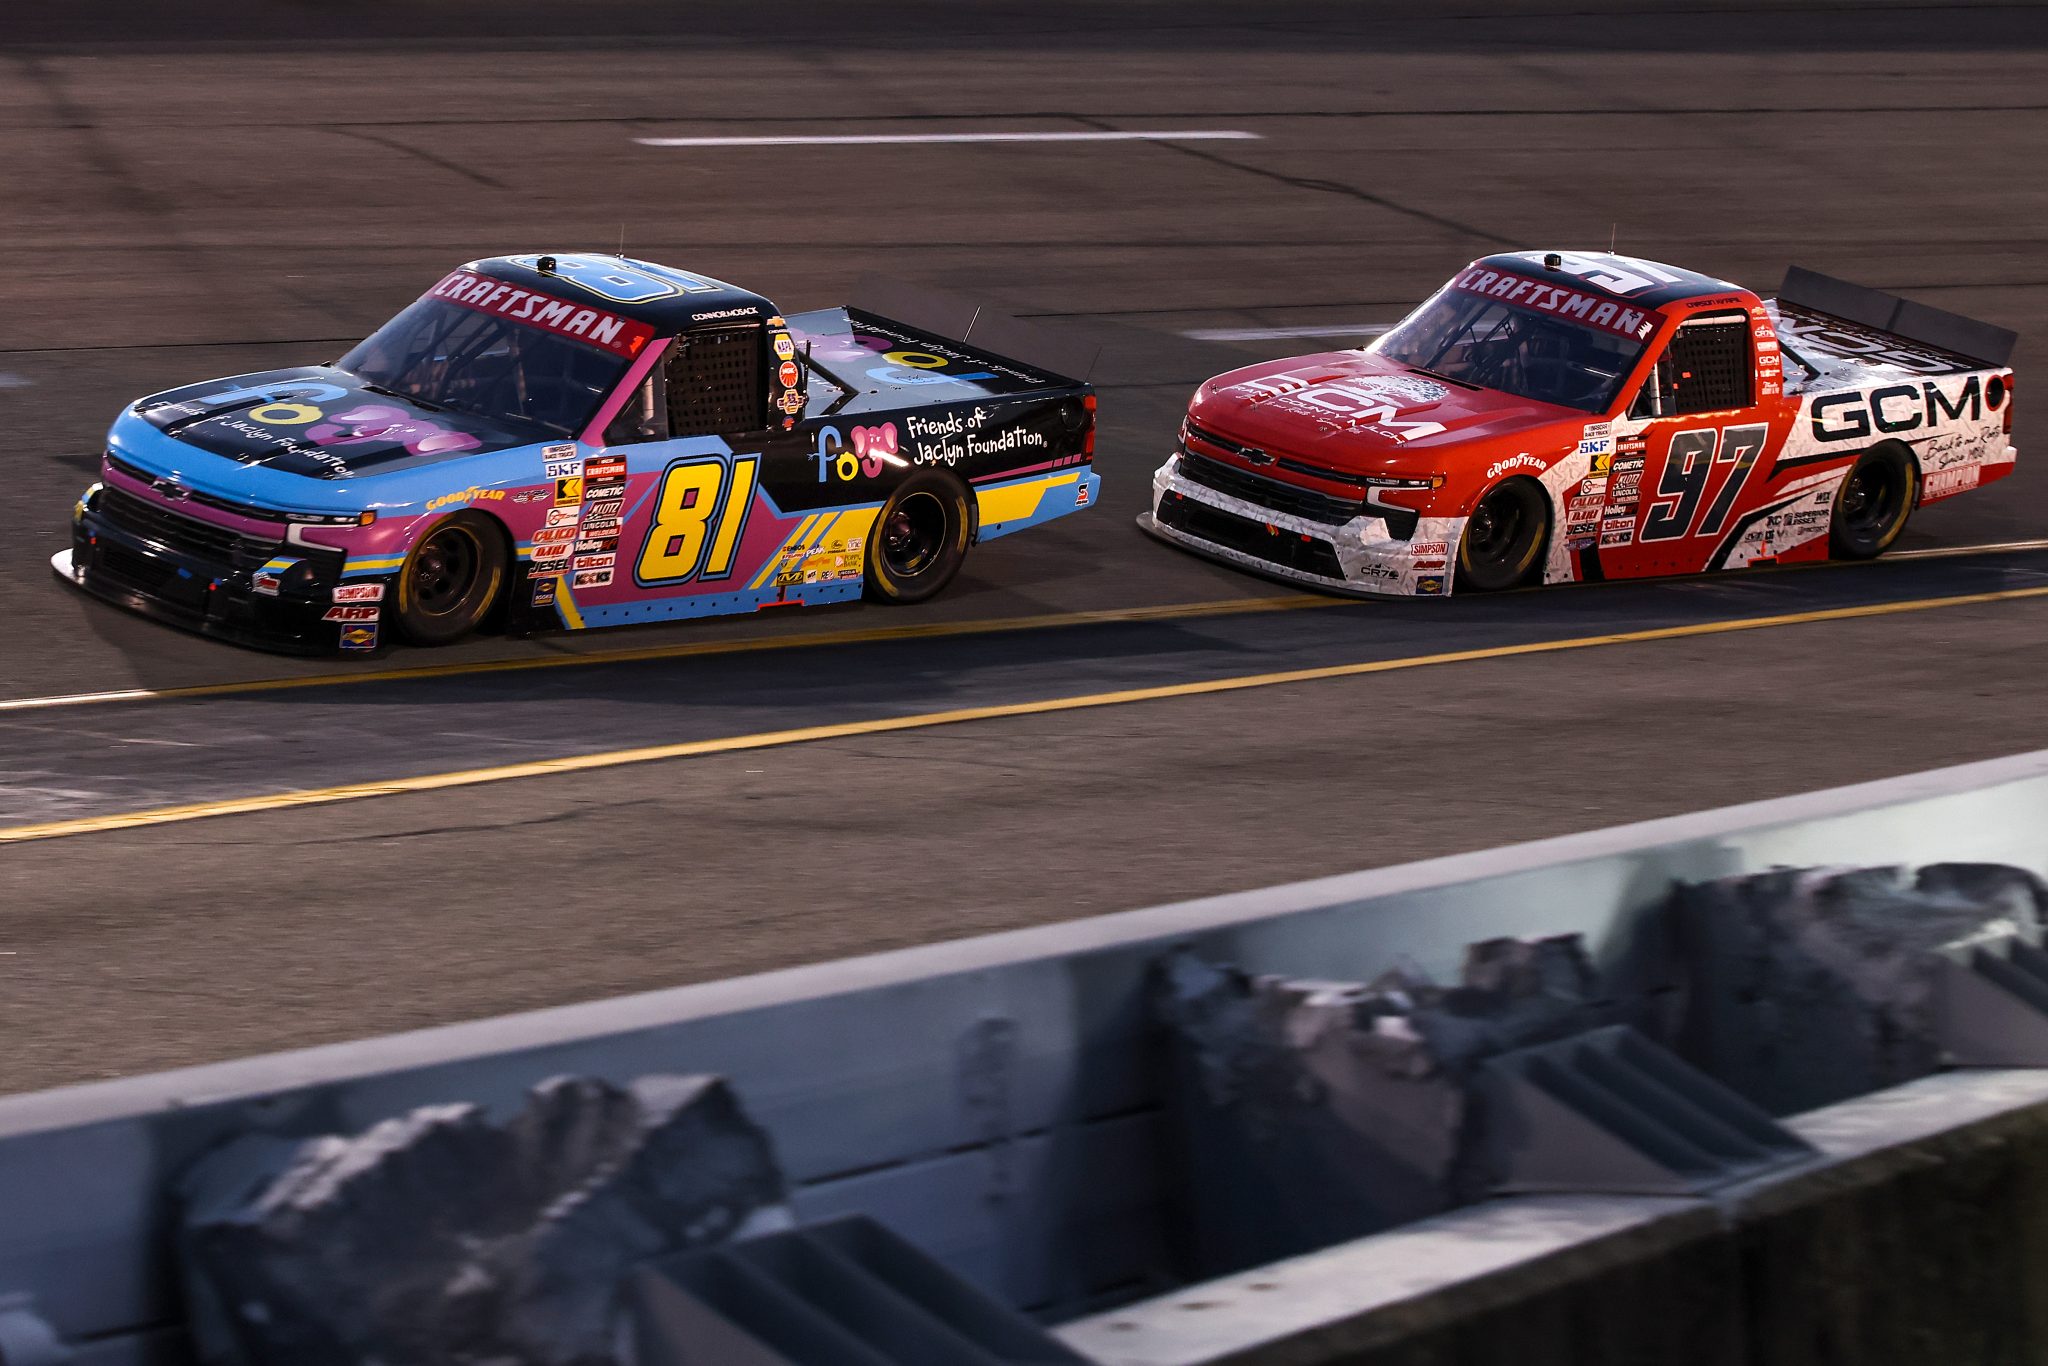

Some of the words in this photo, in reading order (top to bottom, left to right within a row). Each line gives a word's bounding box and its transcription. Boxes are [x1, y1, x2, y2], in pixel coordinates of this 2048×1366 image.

[1458, 268, 1644, 334] CRAFTSMAN
[434, 273, 626, 347] CRAFTSMAN
[1759, 355, 1780, 364] GCM
[1811, 376, 1981, 442] GCM
[906, 412, 963, 439] Friends
[967, 407, 987, 428] of
[913, 437, 964, 466] Jaclyn
[1580, 440, 1609, 454] SKF
[1617, 442, 1645, 451] CRAFTSMAN
[548, 463, 580, 477] SKF
[586, 464, 625, 476] CRAFTSMAN
[1487, 452, 1547, 478] GOODYEAR
[1612, 459, 1644, 471] COMETIC
[1618, 474, 1640, 484] KLOTZ
[1639, 422, 1769, 543] 97
[426, 486, 506, 511] GOODYEAR
[585, 486, 625, 499] COMETIC
[1612, 488, 1637, 497] LINCOLN
[591, 501, 621, 514] KLOTZ
[1604, 505, 1626, 516] Holley
[582, 520, 616, 531] LINCOLN
[632, 452, 762, 589] 81
[1604, 520, 1633, 530] tilton
[1566, 523, 1597, 535] JESEL
[575, 540, 603, 552] Holley
[1414, 544, 1446, 554] SIMPSON
[529, 559, 569, 573] JESEL
[576, 556, 613, 568] tilton
[337, 588, 379, 600] SIMPSON
[325, 607, 378, 619] ARP
